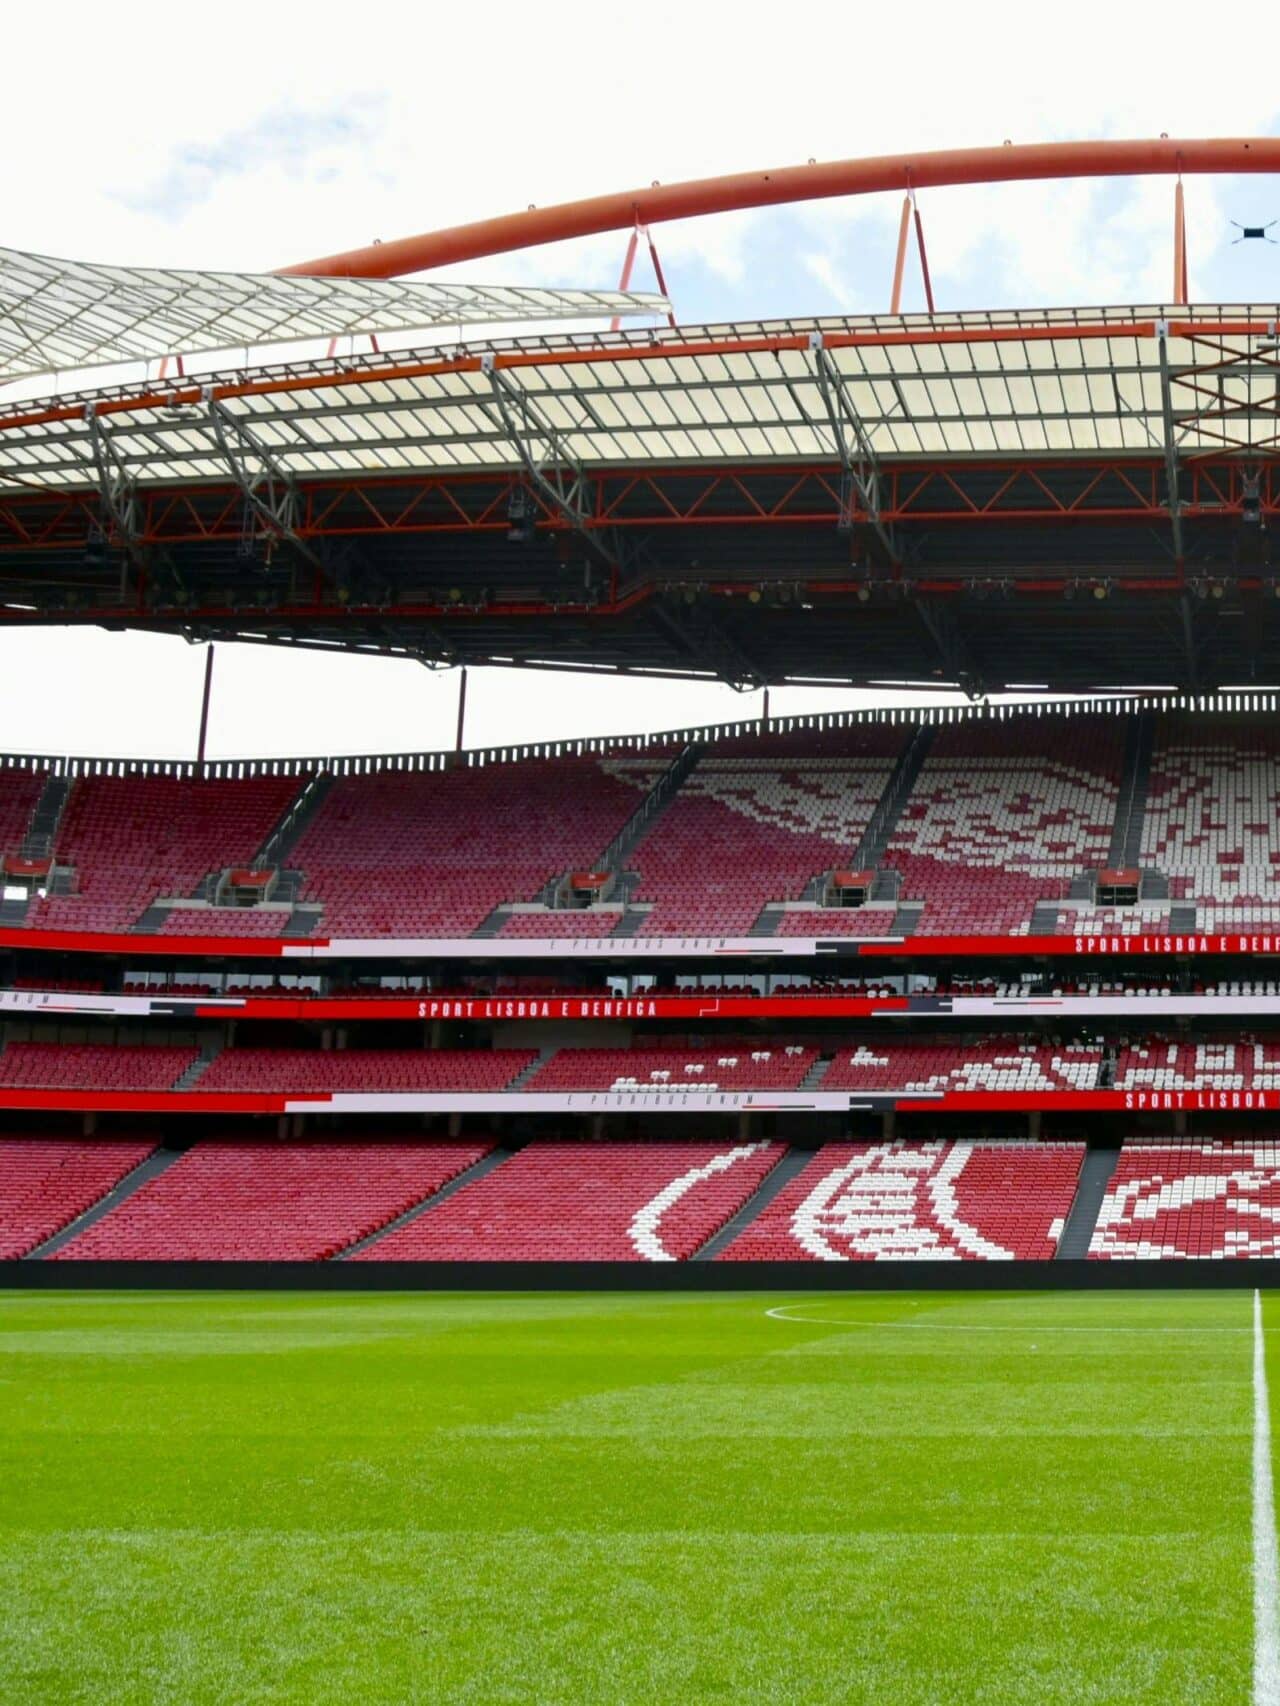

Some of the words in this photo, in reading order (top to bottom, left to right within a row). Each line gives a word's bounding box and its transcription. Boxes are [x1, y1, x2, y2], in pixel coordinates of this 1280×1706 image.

[1075, 938, 1132, 952] SPORT
[1143, 938, 1208, 952] LISBOA
[1220, 937, 1227, 951] E
[418, 1002, 473, 1017] SPORT
[486, 1002, 549, 1017] LISBOA
[562, 1002, 569, 1016] E
[581, 1001, 656, 1016] BENFICA
[1126, 1093, 1184, 1108] SPORT
[1198, 1093, 1265, 1108] LISBOA
